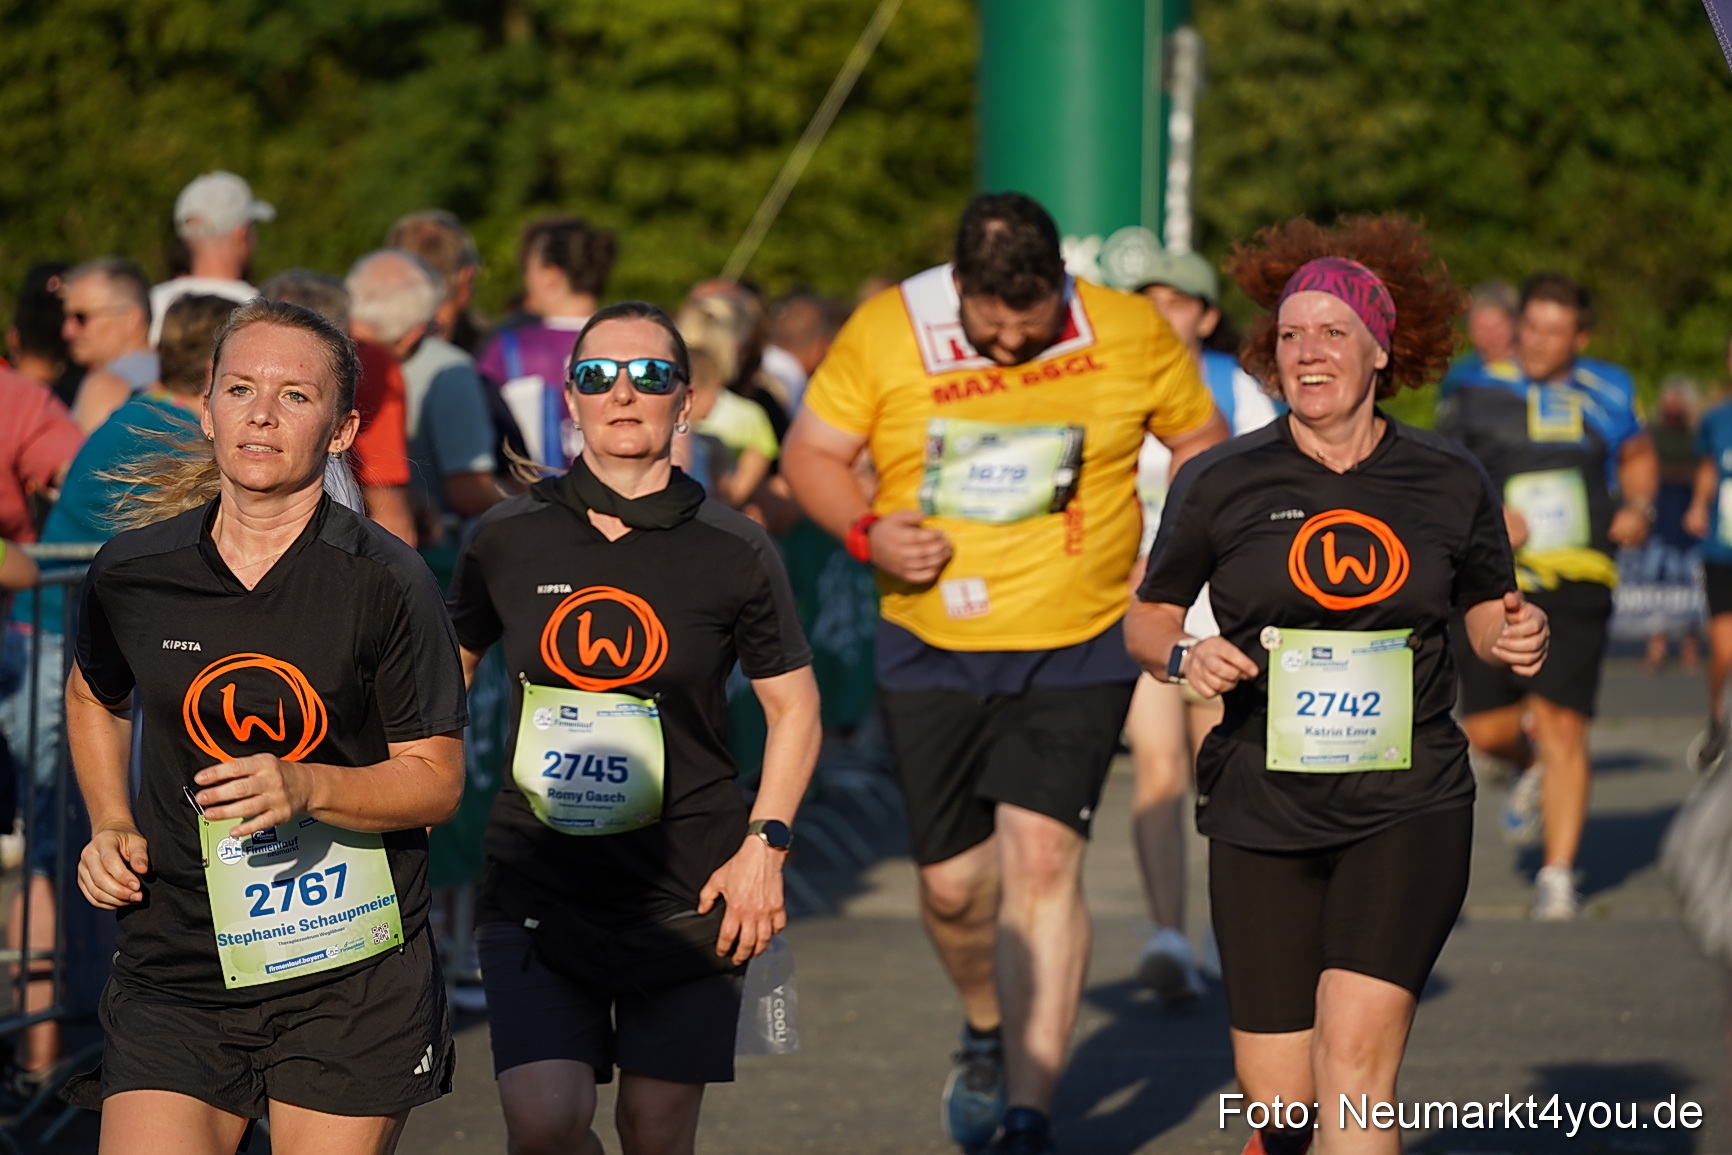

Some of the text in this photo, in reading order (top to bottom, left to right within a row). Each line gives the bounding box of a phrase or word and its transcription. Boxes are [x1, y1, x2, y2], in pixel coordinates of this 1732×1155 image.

[933, 371, 1007, 404] MAX
[537, 584, 572, 595] KIPSTA
[162, 639, 202, 652] KIPSTA
[1296, 691, 1381, 717] 2742
[1304, 725, 1343, 736] Katrin
[542, 750, 629, 784] 2745
[547, 788, 626, 804] Romy Gasch
[246, 836, 299, 856] Firmenlauf
[267, 845, 300, 858] neumarkt
[245, 862, 348, 918] 2767
[218, 894, 396, 947] Stephanie Schaupmeier
[278, 934, 319, 947] Therapiezentrum
[268, 952, 325, 974] firmenlauf.bayern
